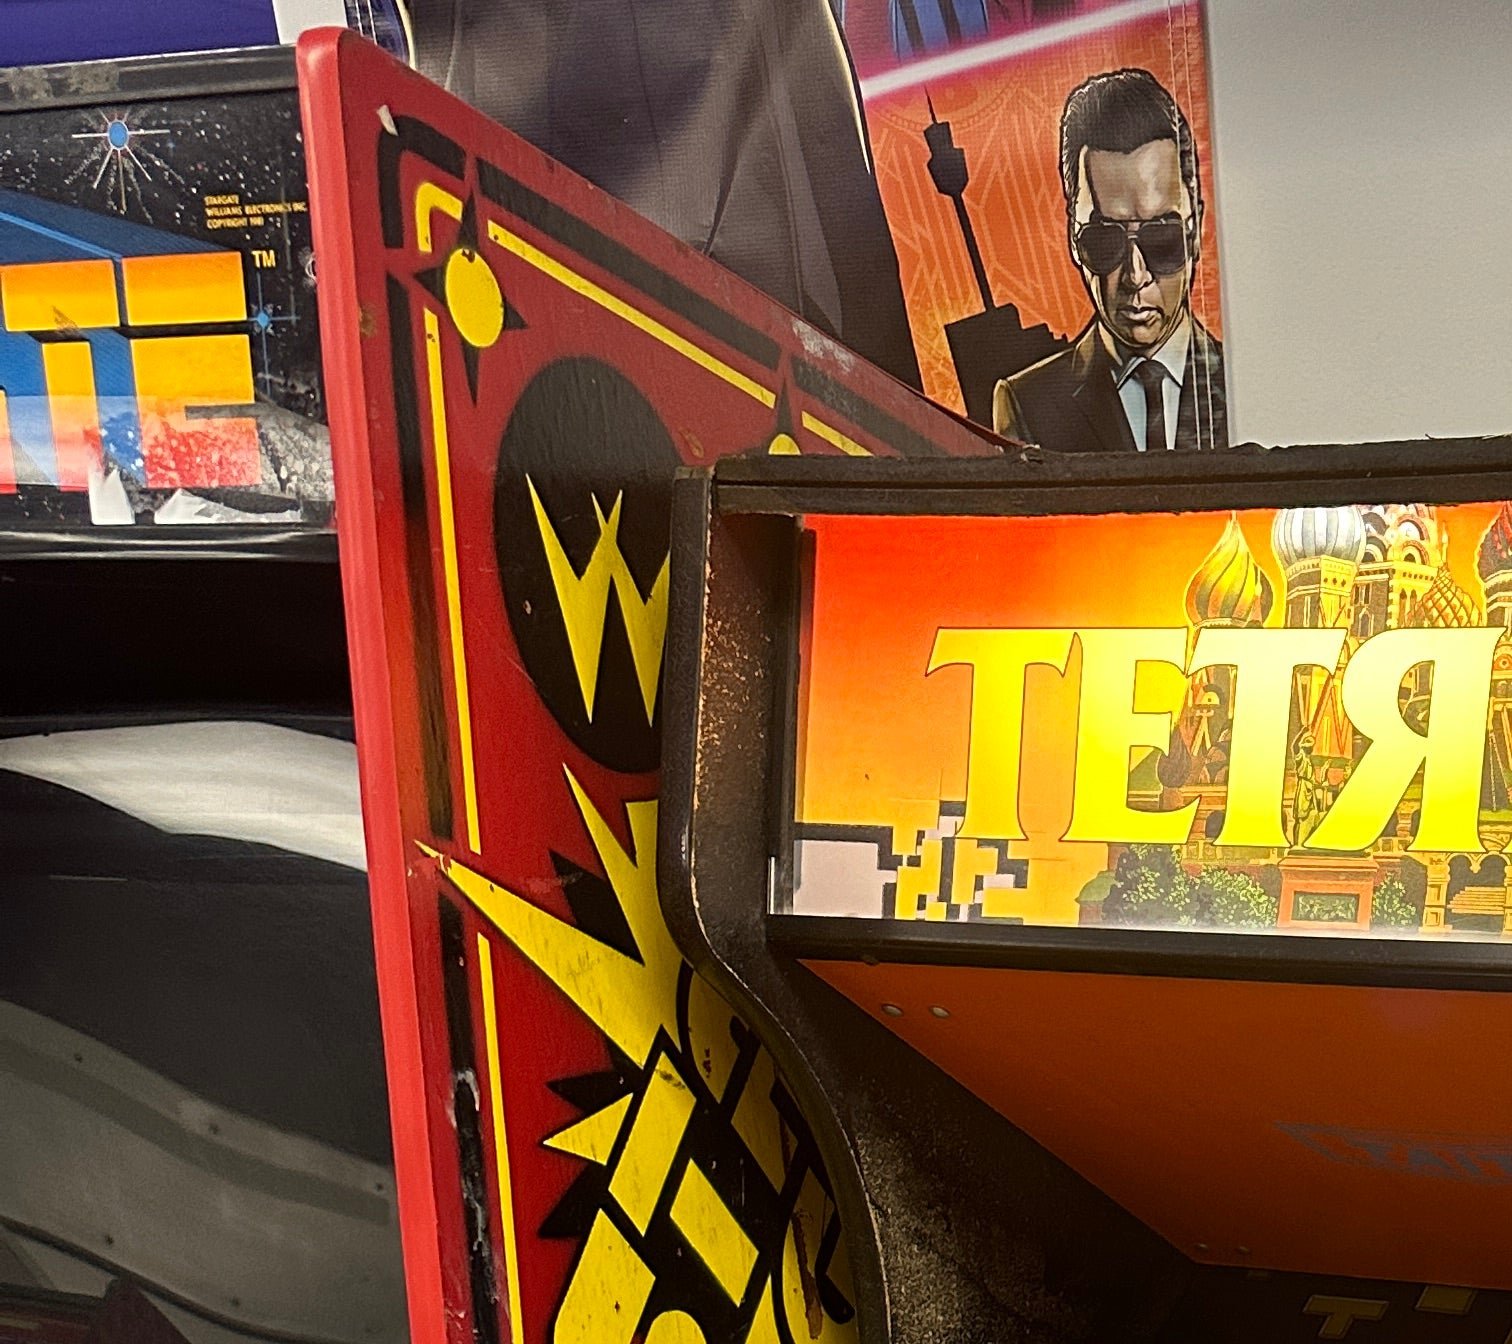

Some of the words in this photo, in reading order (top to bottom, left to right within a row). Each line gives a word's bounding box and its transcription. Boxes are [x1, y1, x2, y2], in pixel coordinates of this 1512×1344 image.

[205, 206, 242, 217] WILLIAMS
[244, 203, 291, 215] ELECTRONICS
[206, 218, 248, 229] COPYRIGHT
[251, 249, 277, 268] TM
